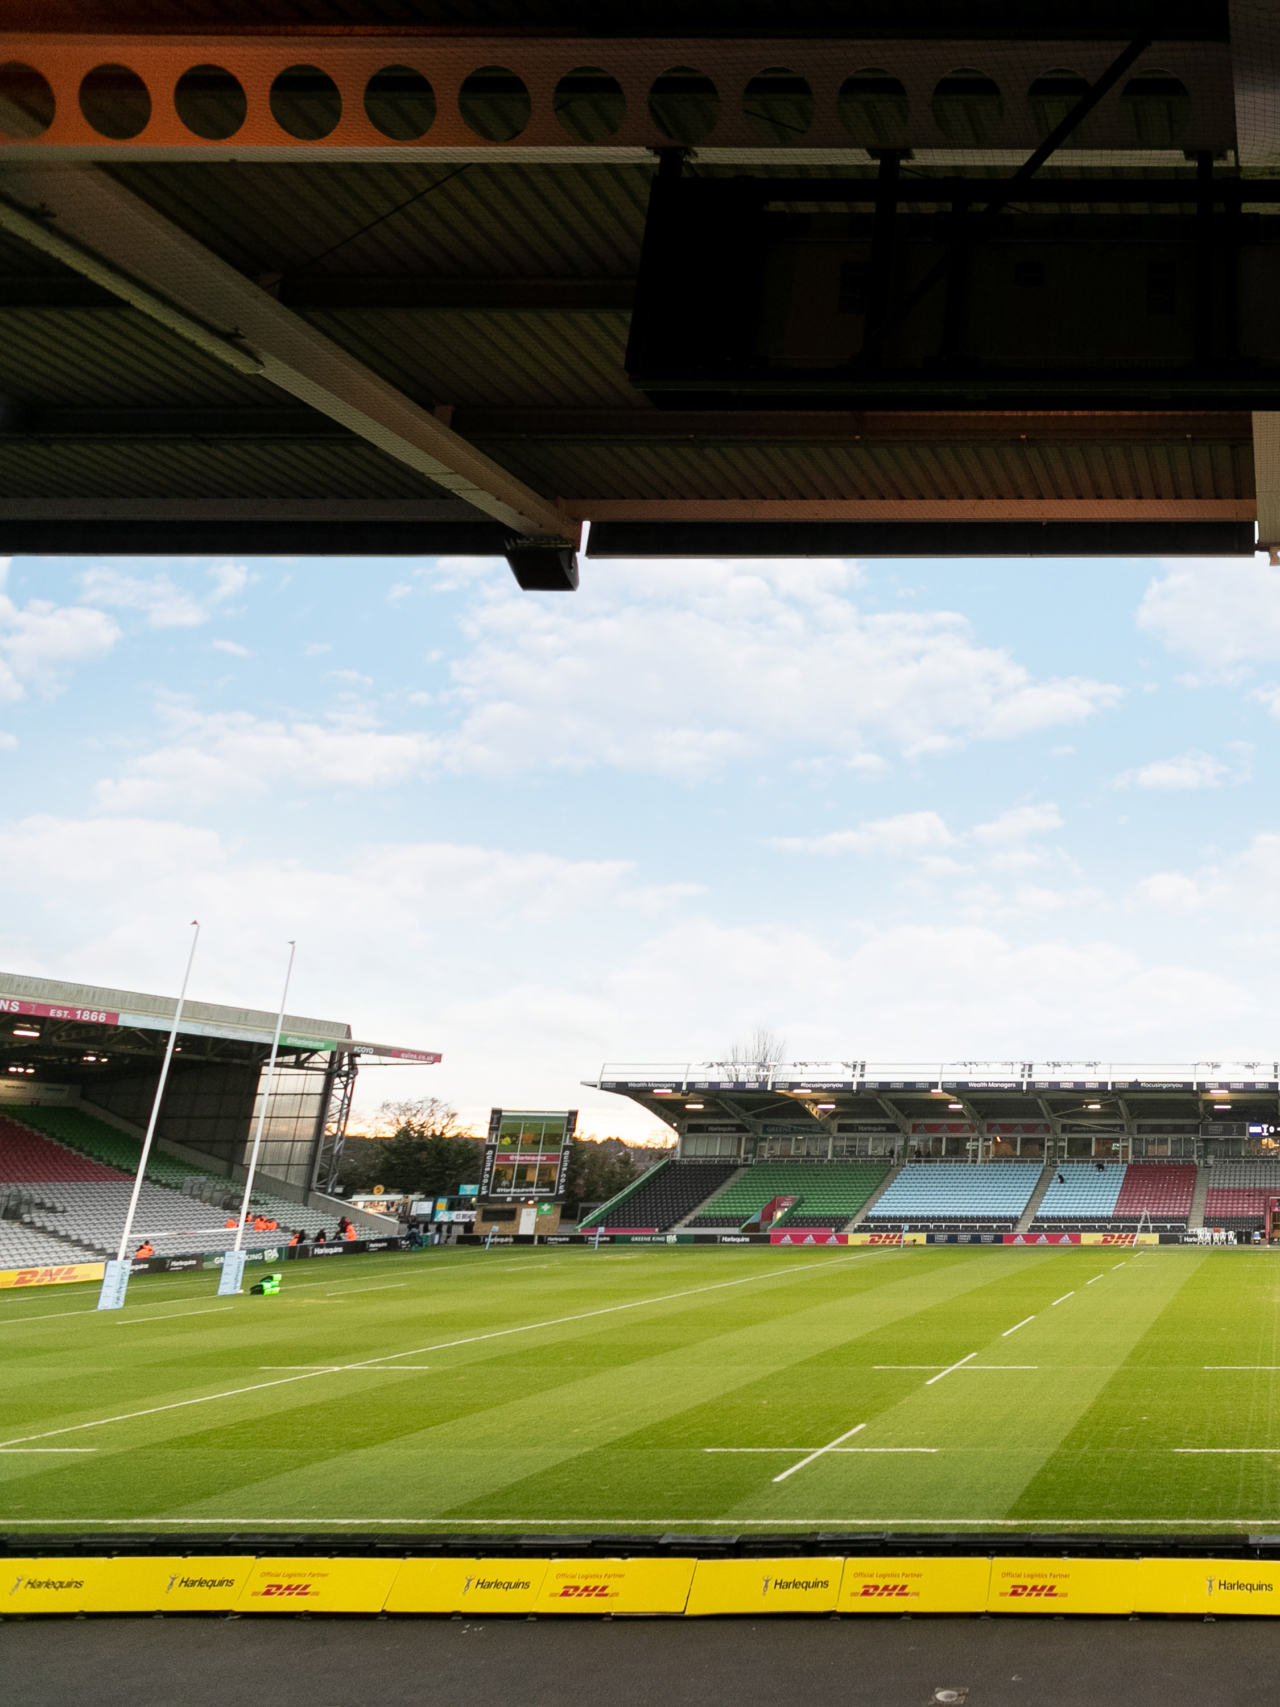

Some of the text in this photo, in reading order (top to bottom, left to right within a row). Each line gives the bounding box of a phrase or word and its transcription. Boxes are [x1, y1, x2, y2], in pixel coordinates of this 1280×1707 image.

[50, 1008, 107, 1023] EST. 1866
[480, 1150, 493, 1195] quins.co.uk
[558, 1150, 570, 1195] quins.co.uk
[869, 1234, 906, 1244] DHL
[1101, 1234, 1137, 1244] DHL
[281, 1571, 306, 1579] Logistics
[556, 1572, 625, 1581] Official Logistics Partner
[874, 1572, 900, 1580] Logistics
[1021, 1572, 1047, 1580] Logistics
[24, 1578, 84, 1591] Harlequins
[178, 1576, 235, 1589] Harlequins
[475, 1579, 530, 1592] Harlequins
[774, 1578, 829, 1591] Harlequins
[1218, 1579, 1273, 1593] Harlequins
[261, 1584, 314, 1597] DHL
[559, 1585, 610, 1597] DHL
[860, 1584, 911, 1597] DHL
[1008, 1584, 1060, 1597] DHL
